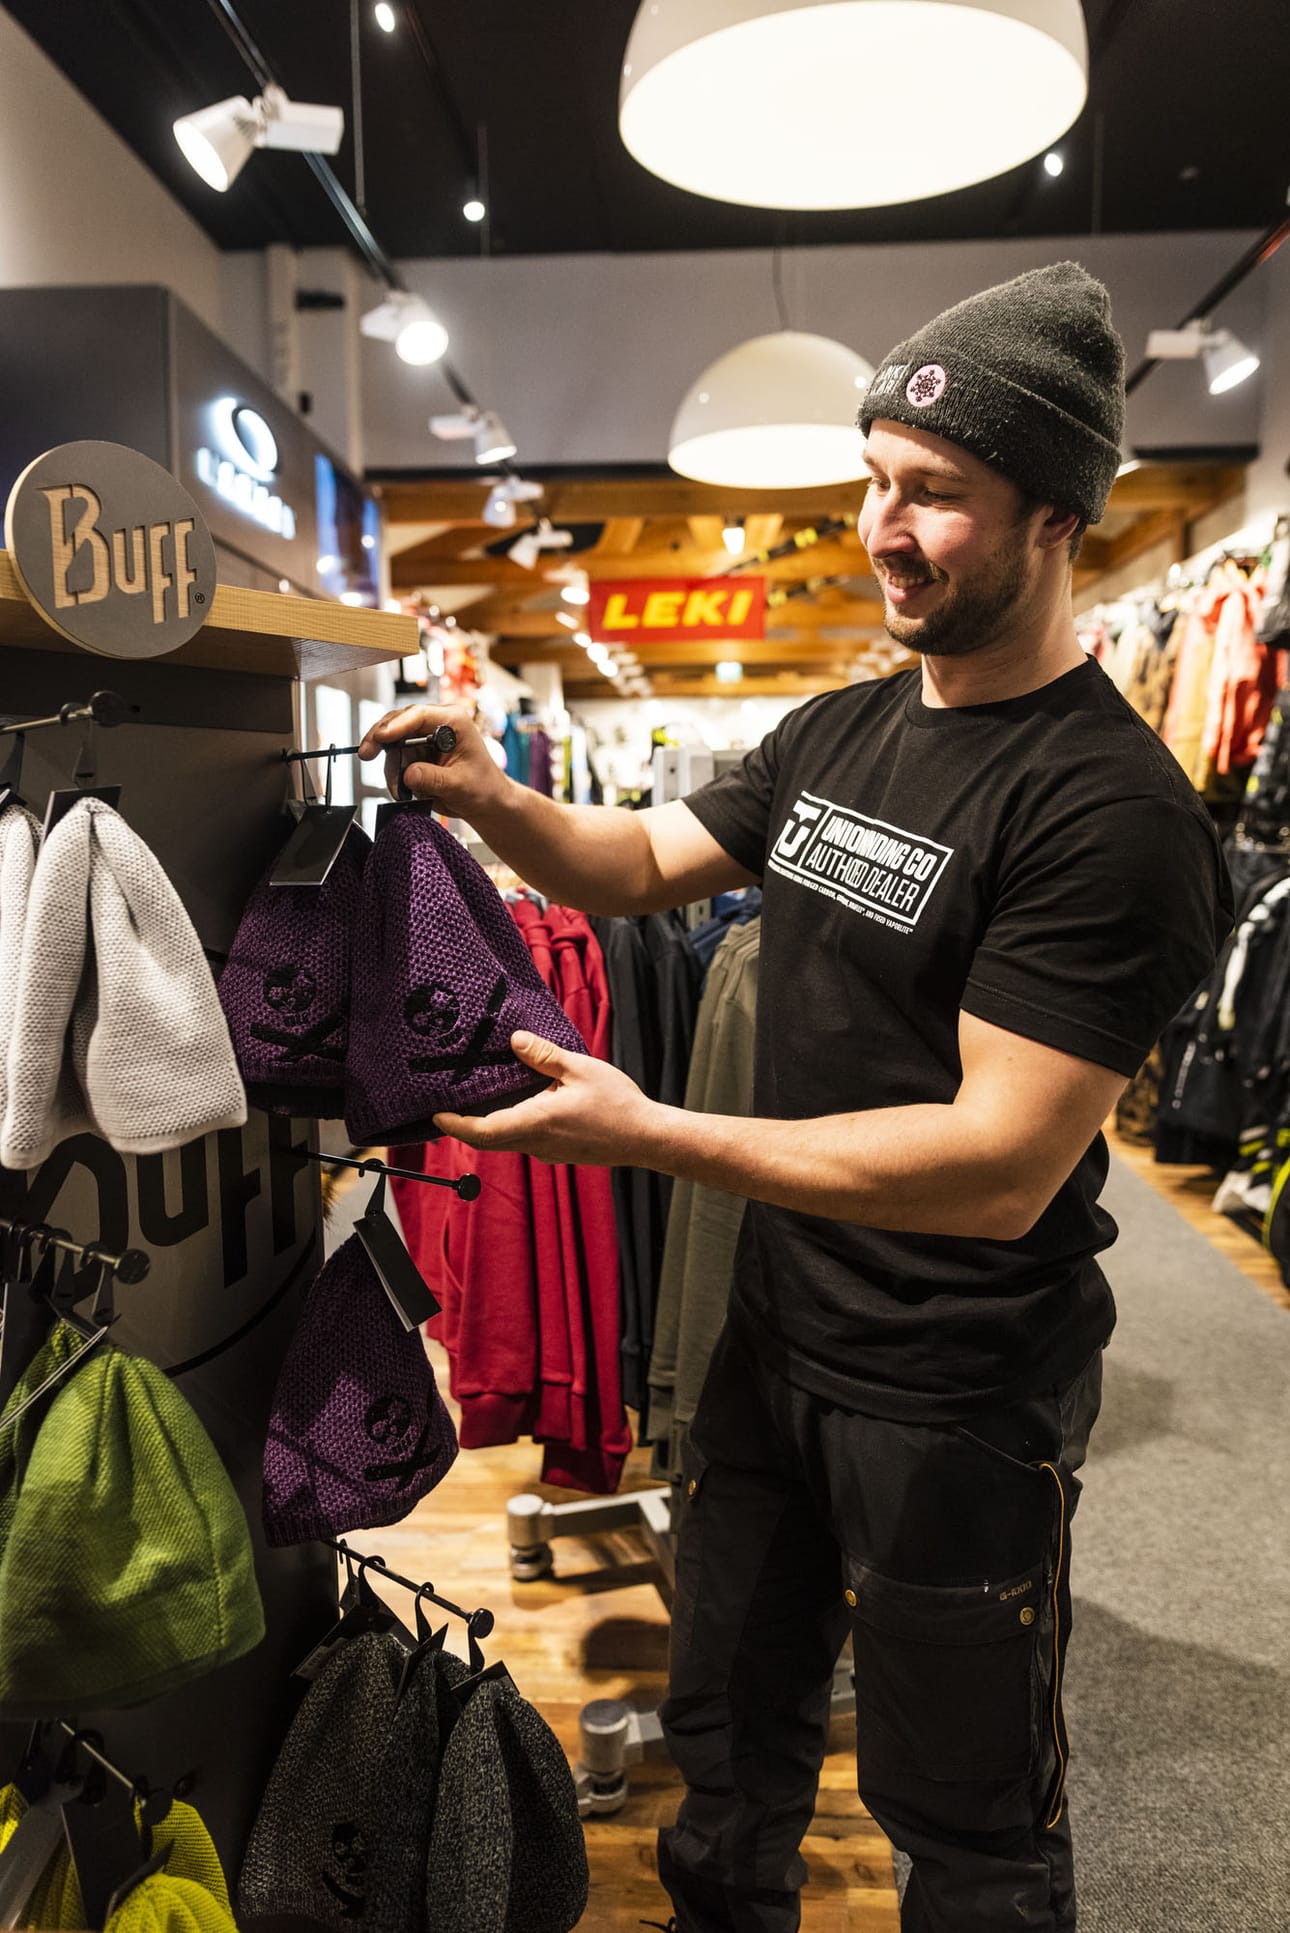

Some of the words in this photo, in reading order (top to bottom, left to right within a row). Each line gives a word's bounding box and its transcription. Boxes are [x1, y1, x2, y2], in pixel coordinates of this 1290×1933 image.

[602, 589, 753, 631] LEKI
[902, 848, 938, 882] CO
[861, 867, 920, 912] DEALER
